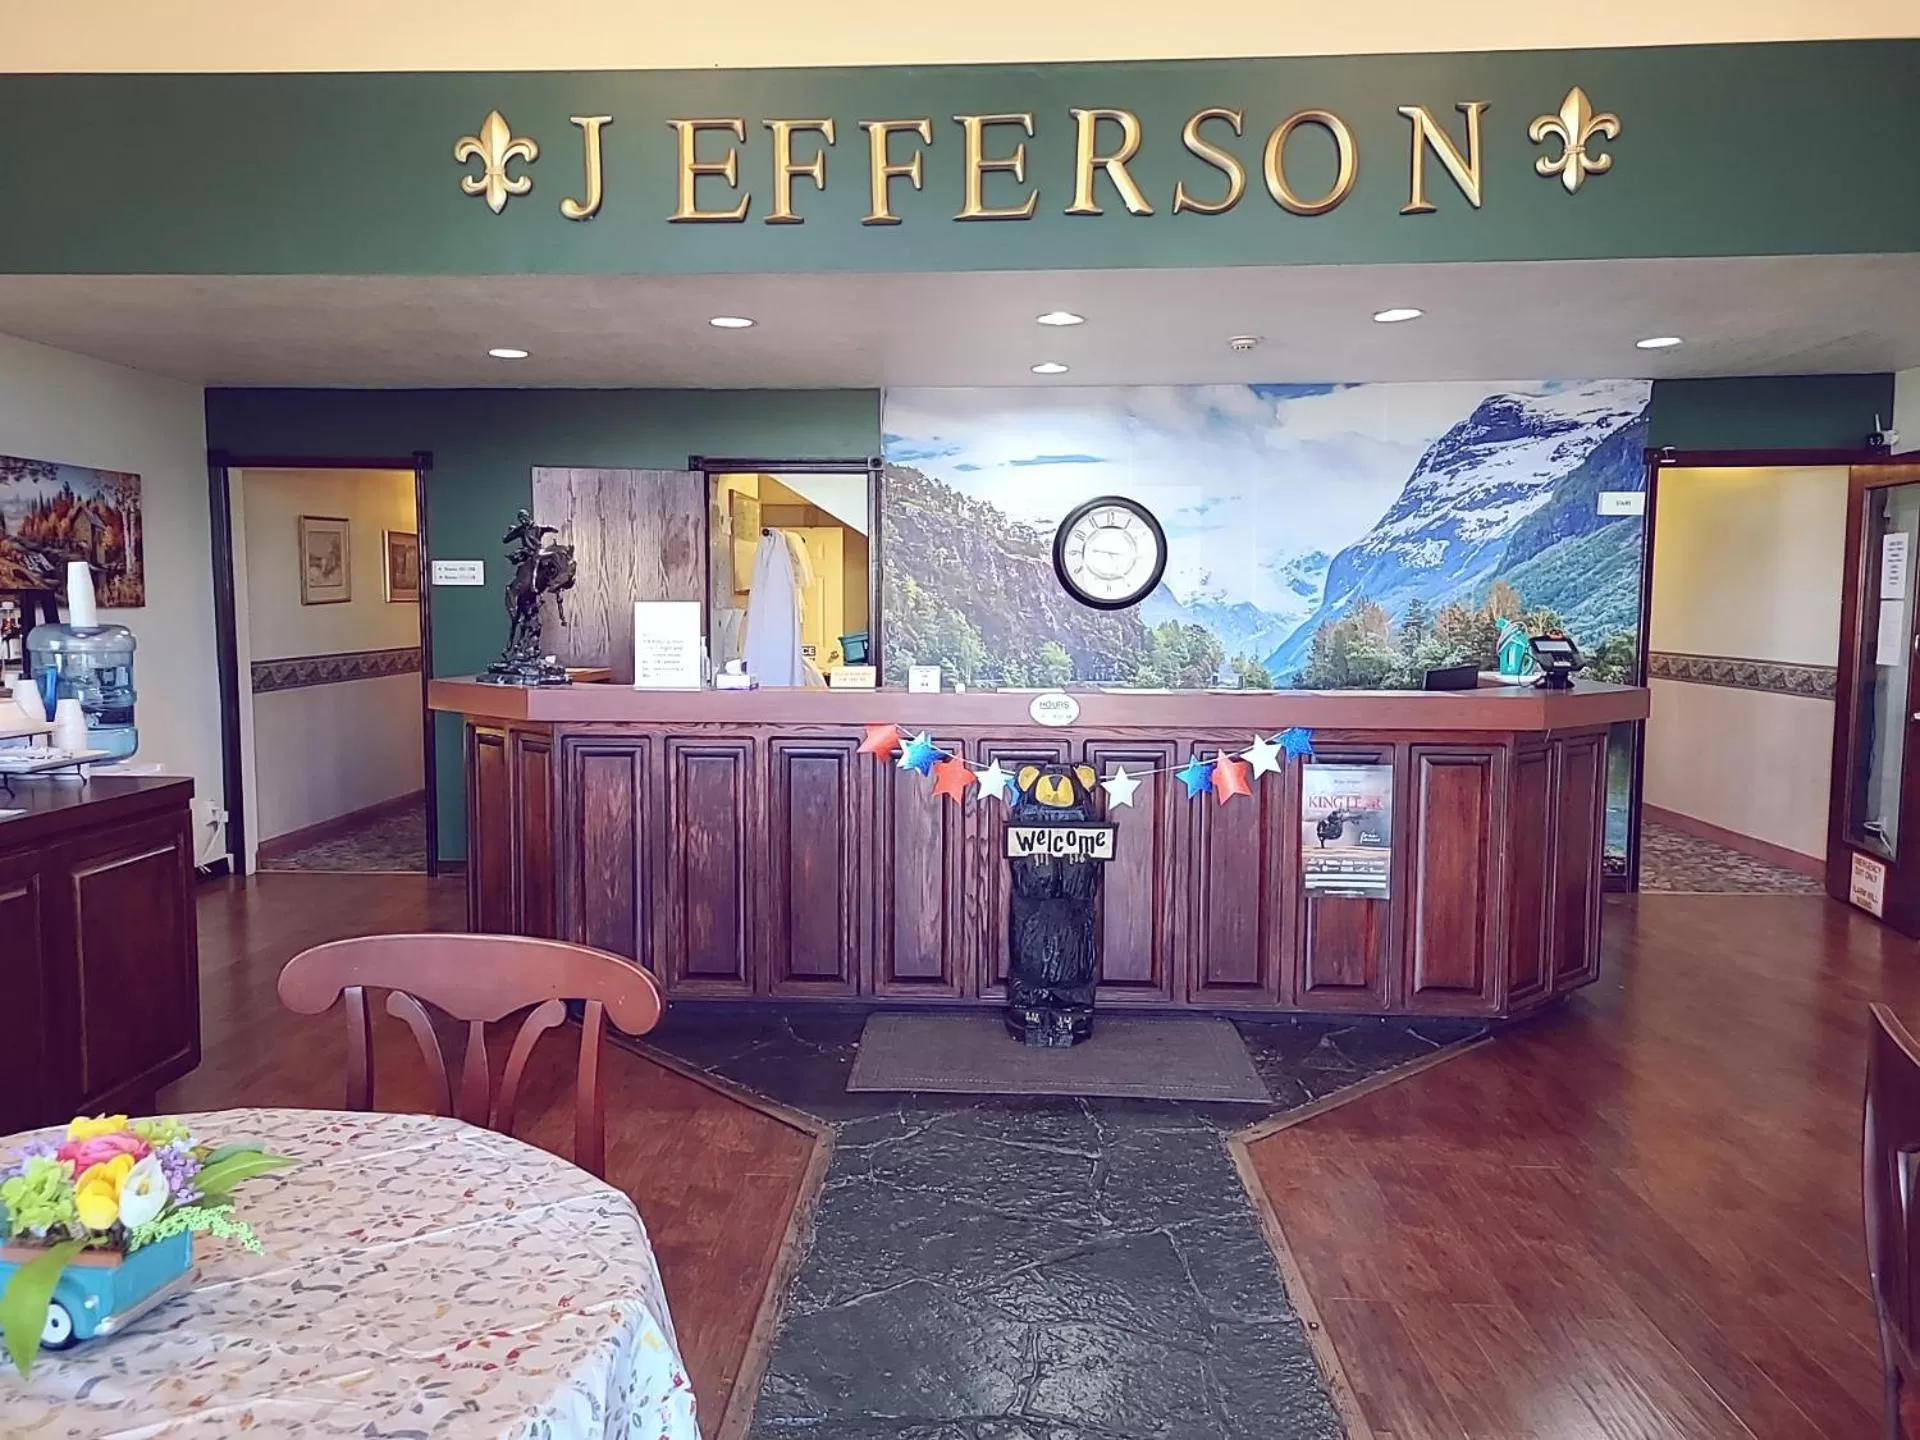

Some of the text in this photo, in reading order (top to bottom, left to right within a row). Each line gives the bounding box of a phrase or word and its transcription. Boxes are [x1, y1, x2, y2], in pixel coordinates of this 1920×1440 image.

[560, 101, 1491, 225] JEFFERSON
[1309, 795, 1384, 810] KING LER
[1015, 829, 1106, 854] Welcome
